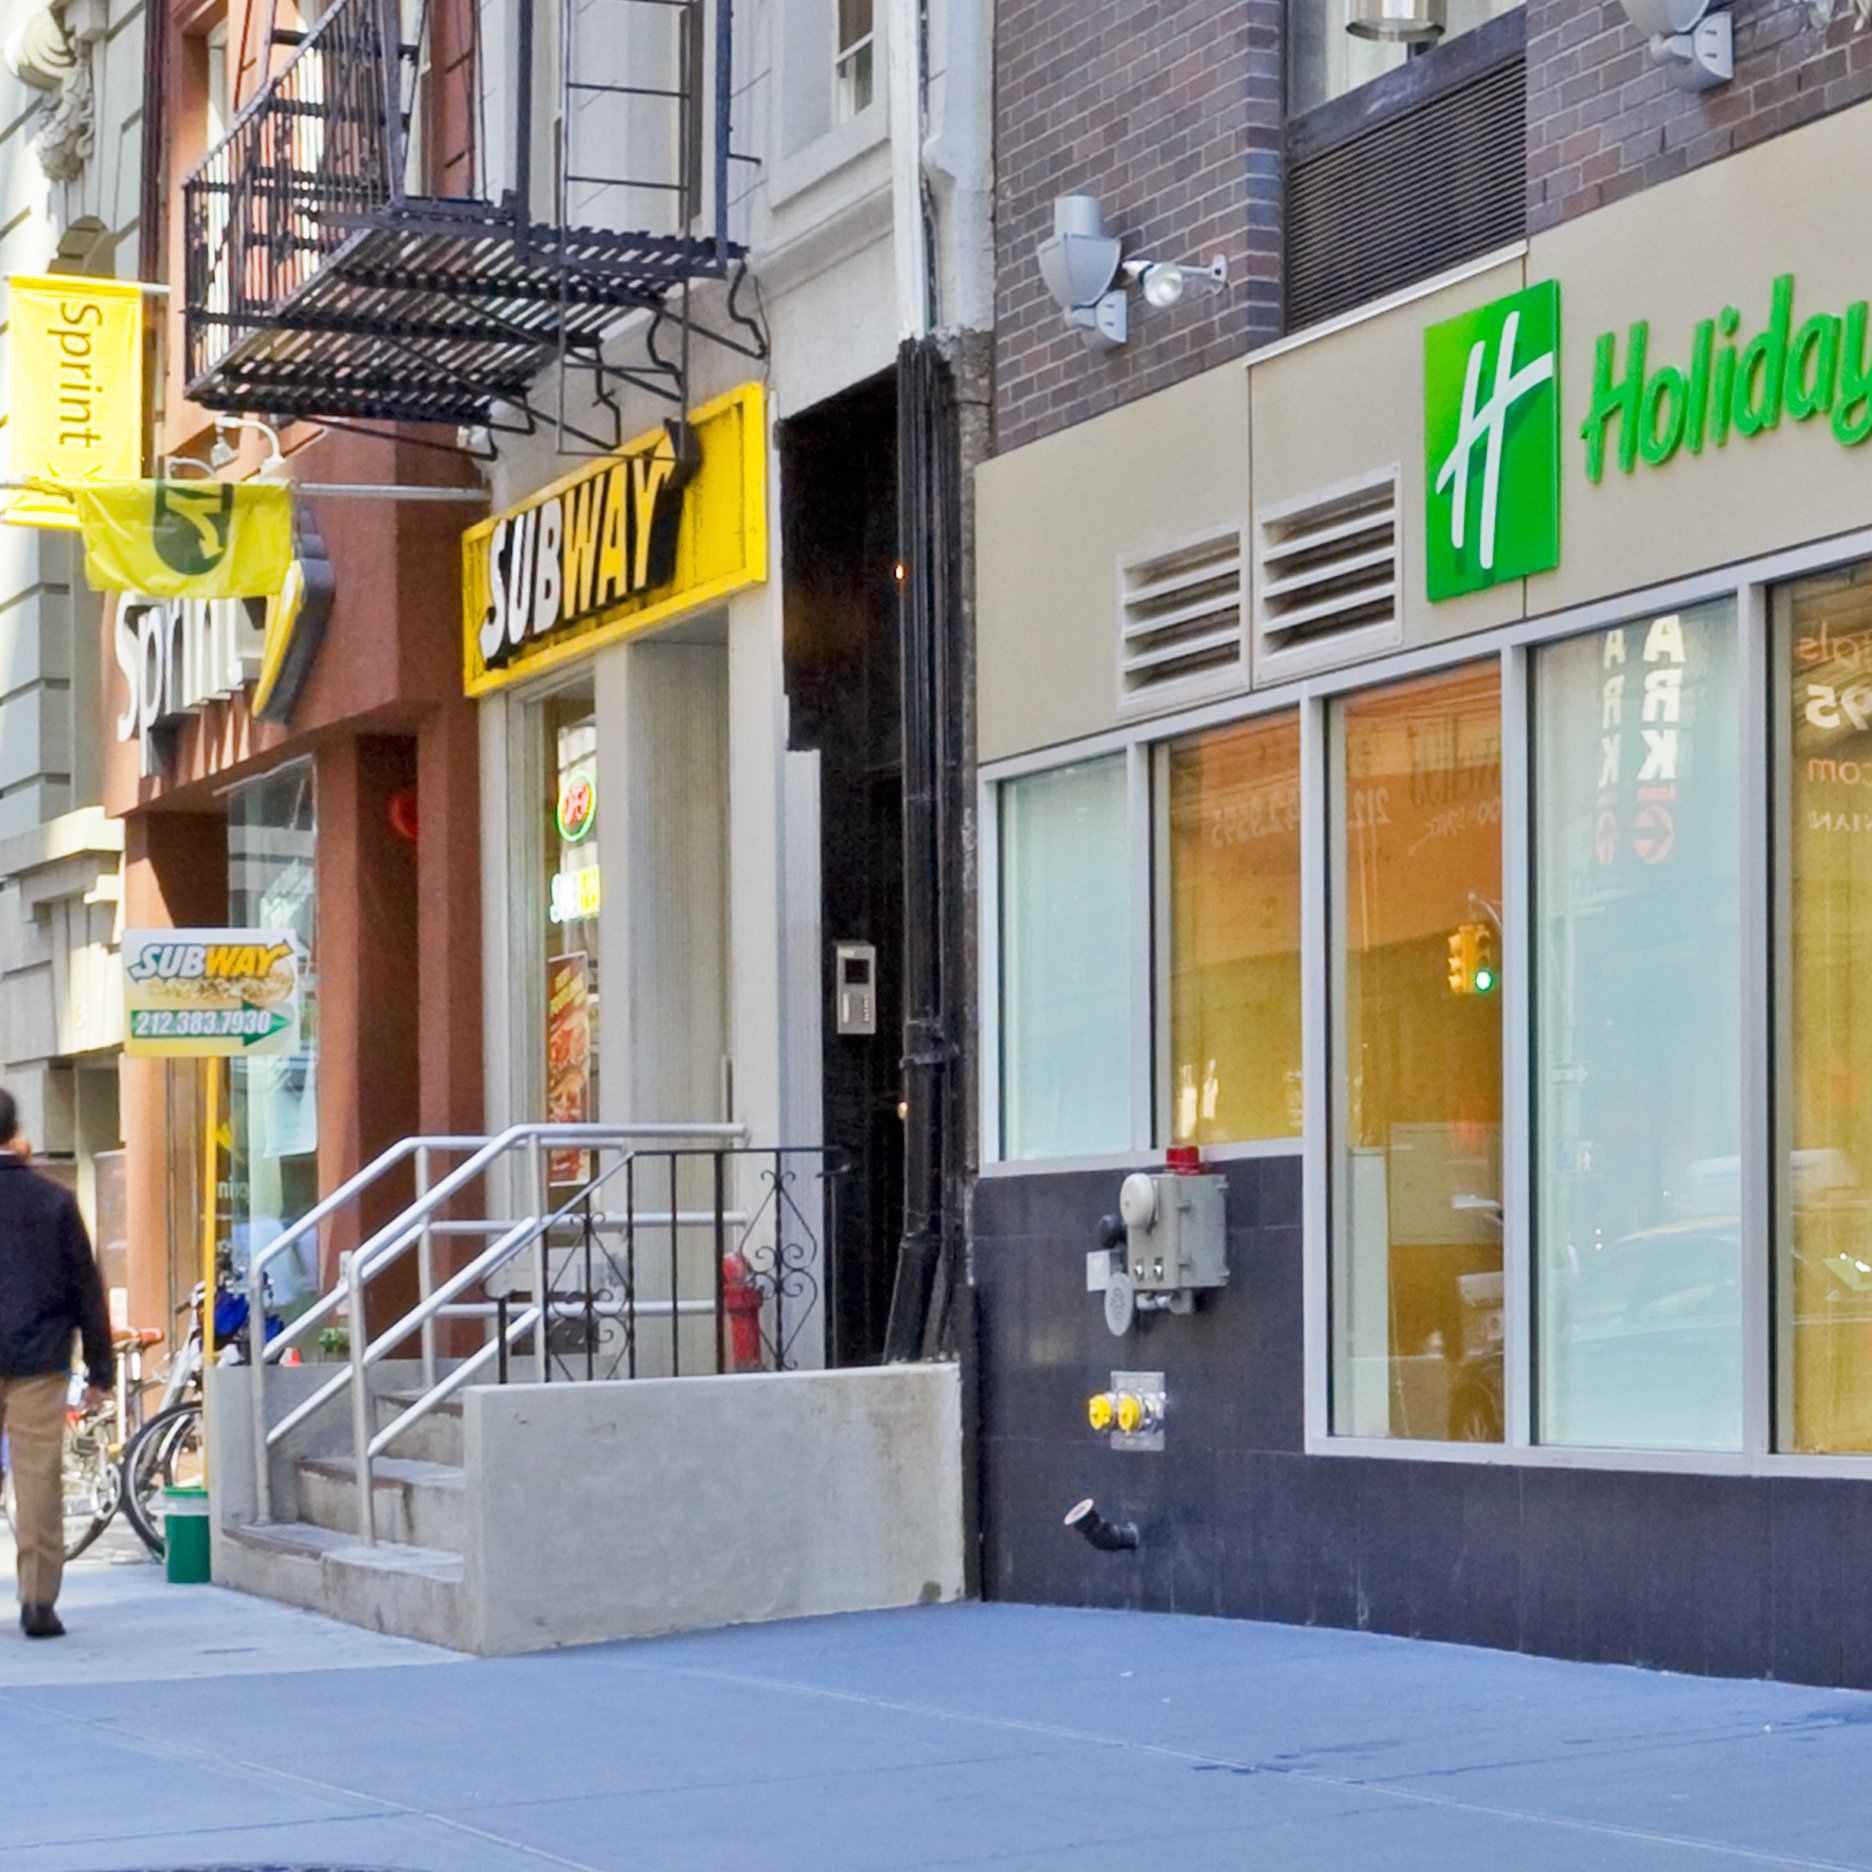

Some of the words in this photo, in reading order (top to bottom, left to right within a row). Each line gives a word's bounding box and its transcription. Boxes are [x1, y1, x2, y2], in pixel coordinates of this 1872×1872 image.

[47, 301, 103, 448] Sprint
[479, 431, 677, 665] SUBWAY
[127, 939, 294, 983] SUBWAY
[135, 1009, 273, 1036] 212.383.7930
